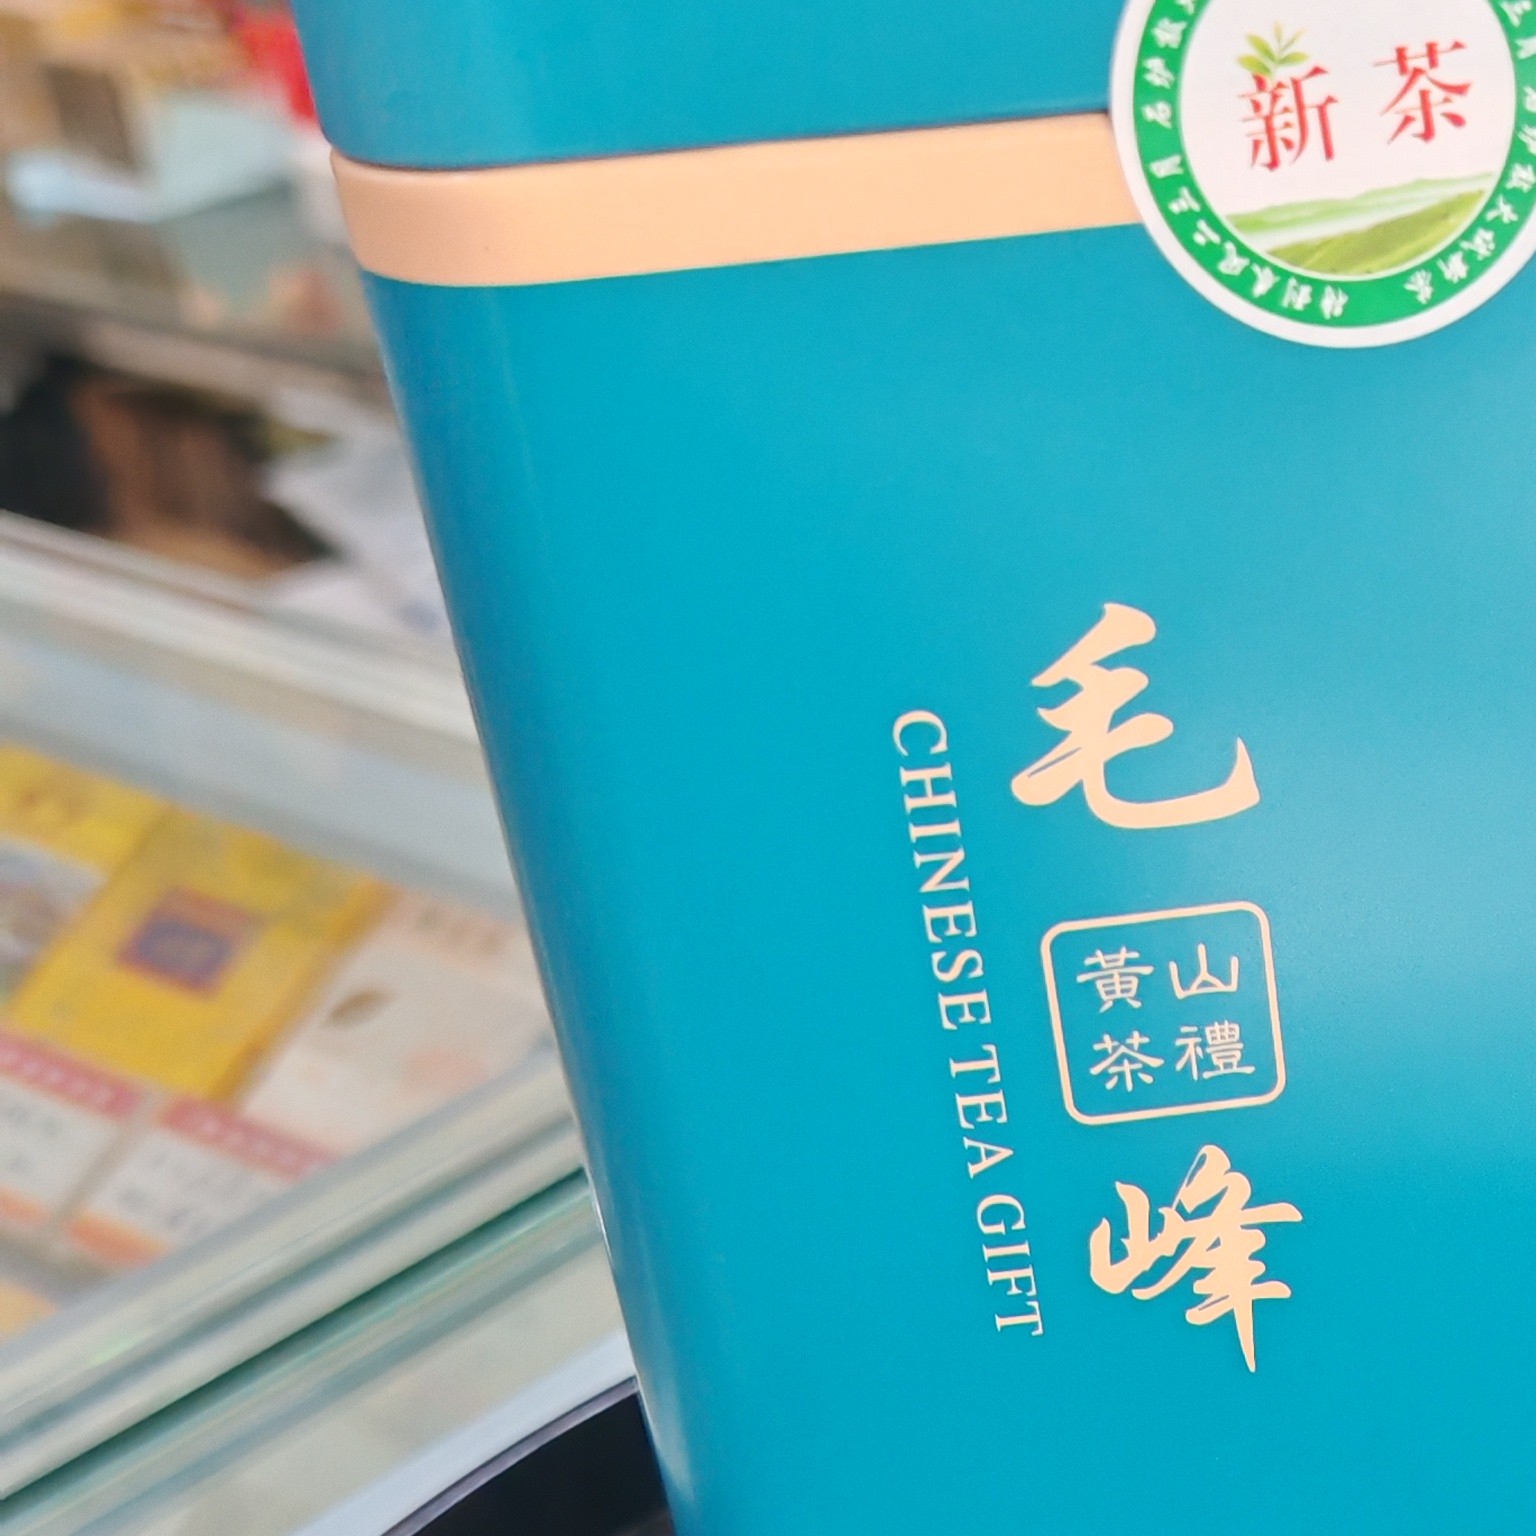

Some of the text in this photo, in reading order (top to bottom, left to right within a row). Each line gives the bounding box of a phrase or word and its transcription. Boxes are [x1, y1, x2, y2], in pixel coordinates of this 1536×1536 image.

[1237, 39, 1474, 172] 新茶
[892, 709, 1044, 1337] CHINESE TEA GIFT
[1010, 602, 1303, 1372] 毛 峰
